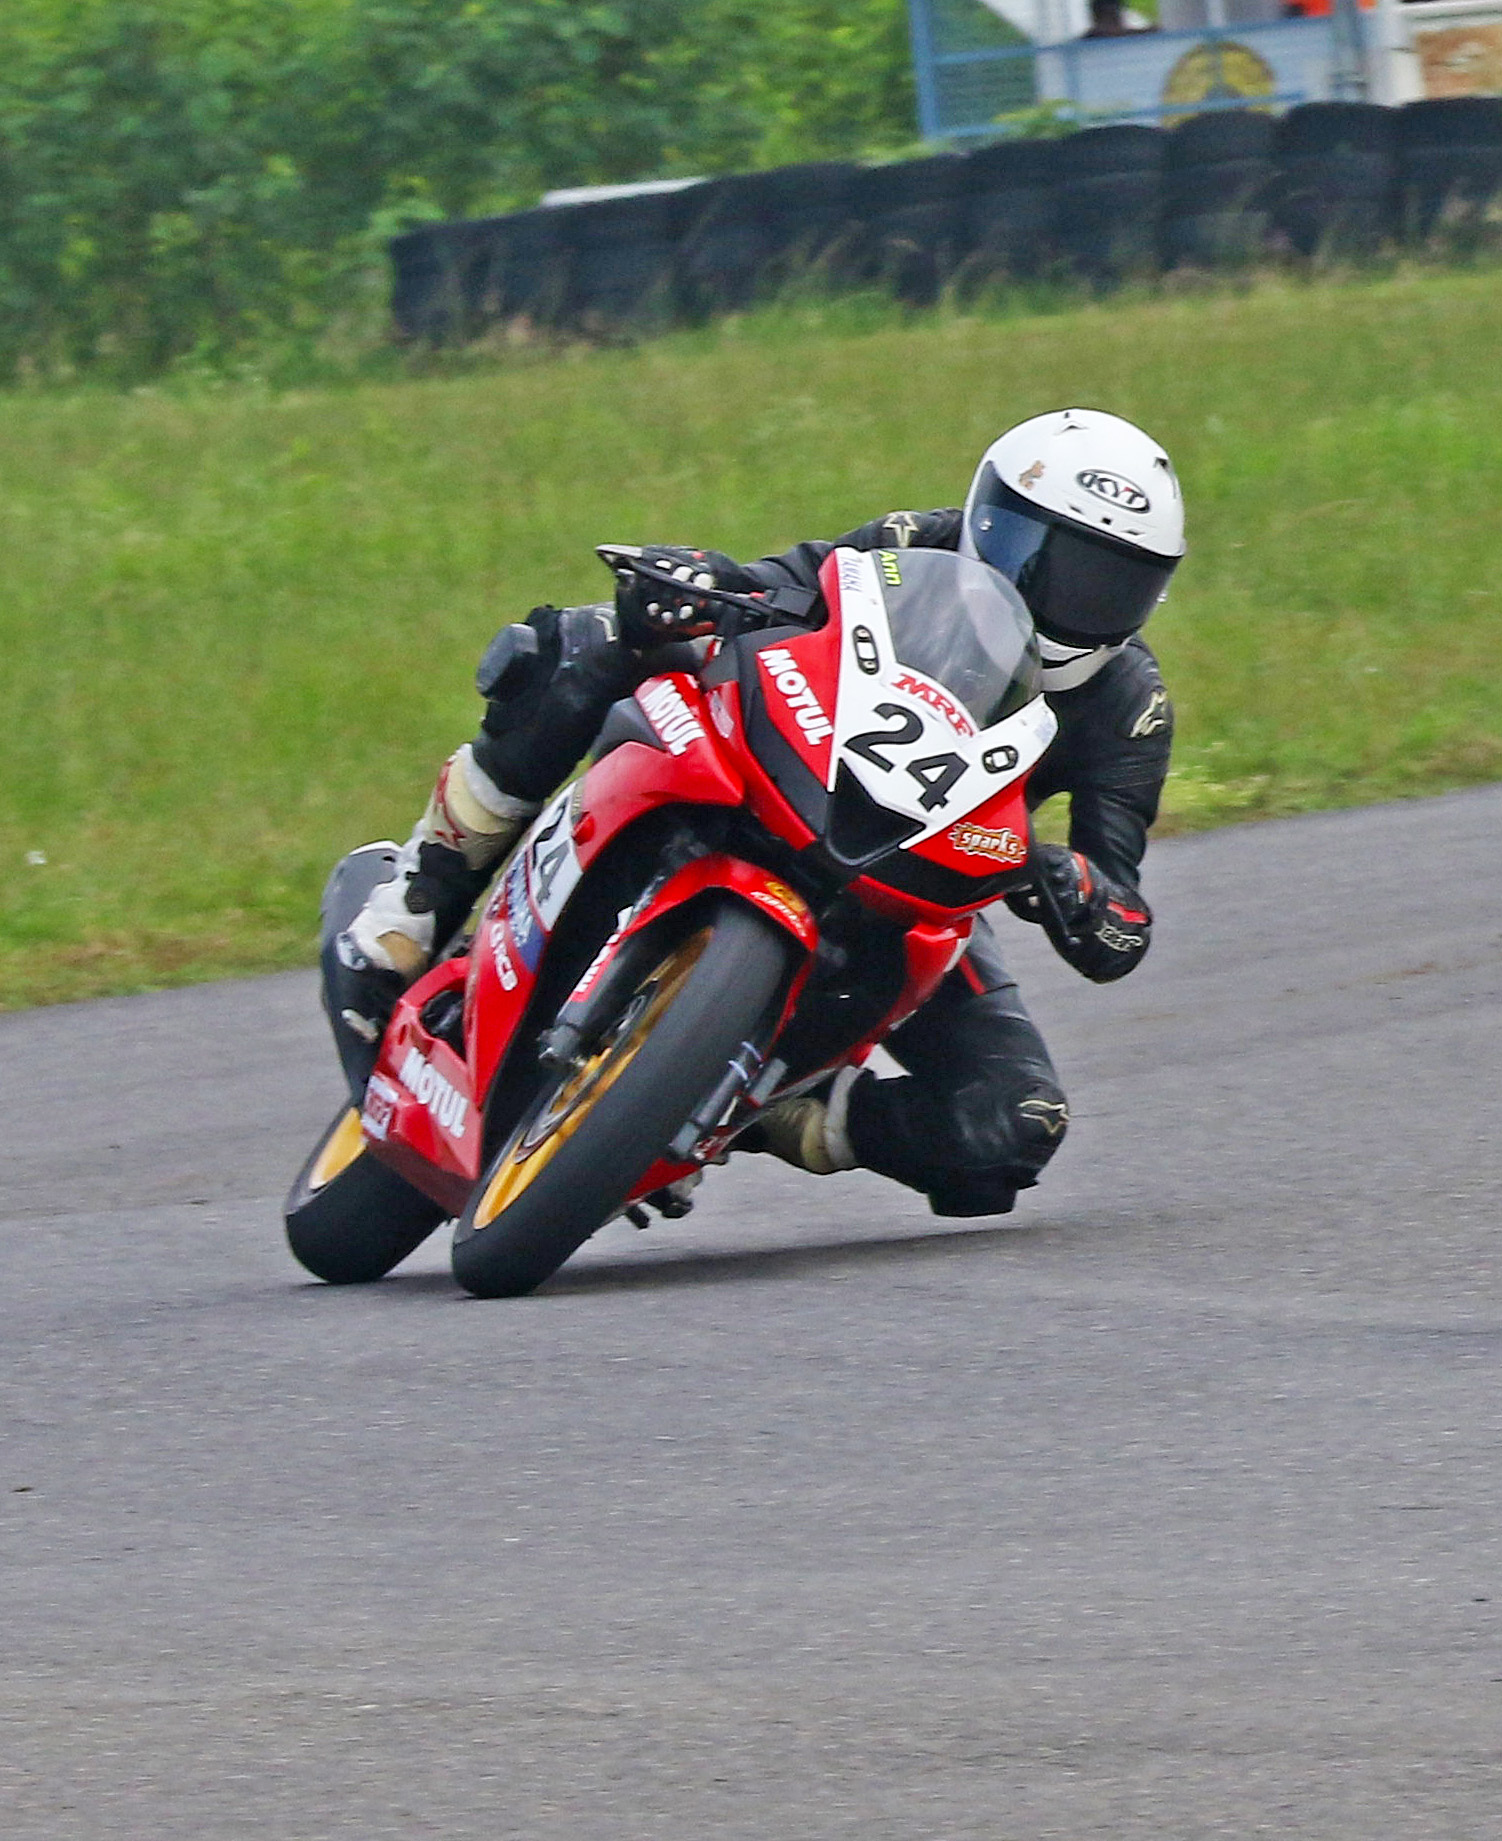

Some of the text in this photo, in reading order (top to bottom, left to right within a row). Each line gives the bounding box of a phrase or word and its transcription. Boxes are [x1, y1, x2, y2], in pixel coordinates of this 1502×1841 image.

[1078, 471, 1147, 507] KYT
[639, 678, 706, 756] MOTUL
[757, 648, 834, 745] MOTUL
[891, 672, 976, 738] MRF
[844, 702, 970, 812] 24
[960, 826, 1018, 855] sparks
[399, 1046, 468, 1138] MOTUL
